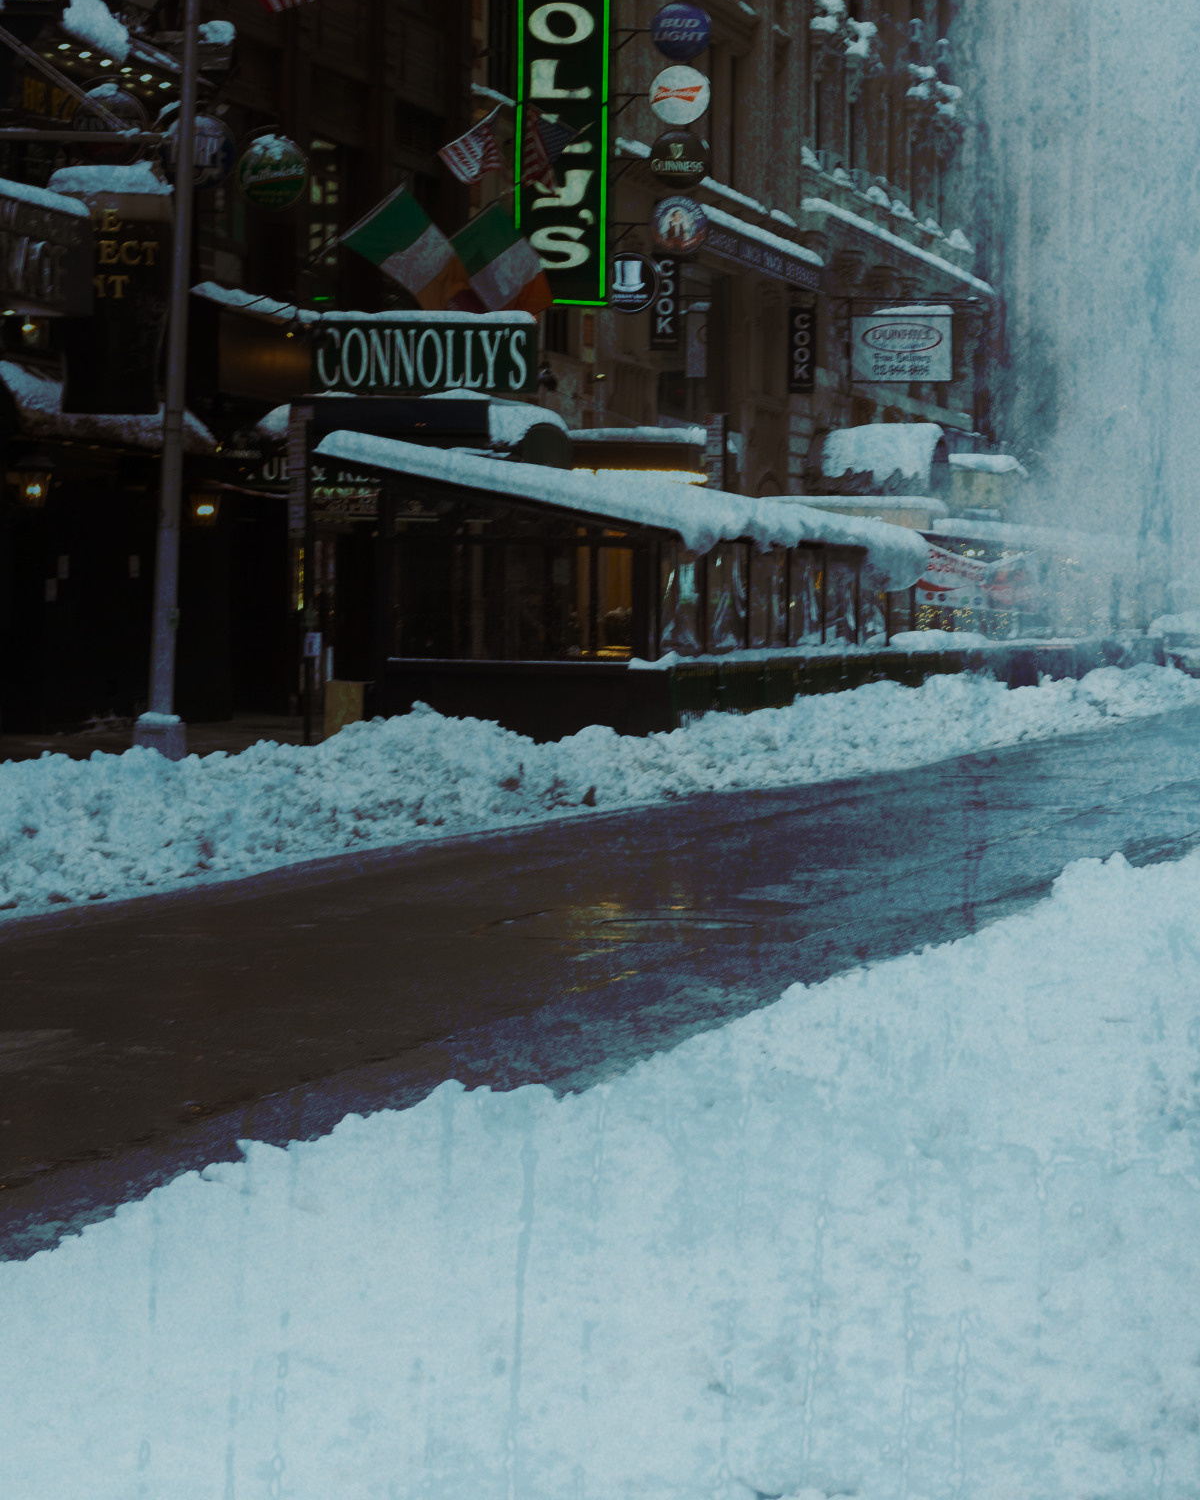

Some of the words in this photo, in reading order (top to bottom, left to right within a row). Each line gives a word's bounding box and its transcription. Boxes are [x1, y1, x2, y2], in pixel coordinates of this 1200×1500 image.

[653, 30, 709, 42] LIGHT
[660, 18, 701, 29] BUD
[651, 158, 705, 173] GUINNESS
[656, 259, 676, 335] COOK
[316, 327, 526, 389] CONNOLLY'S
[791, 311, 812, 380] COOK
